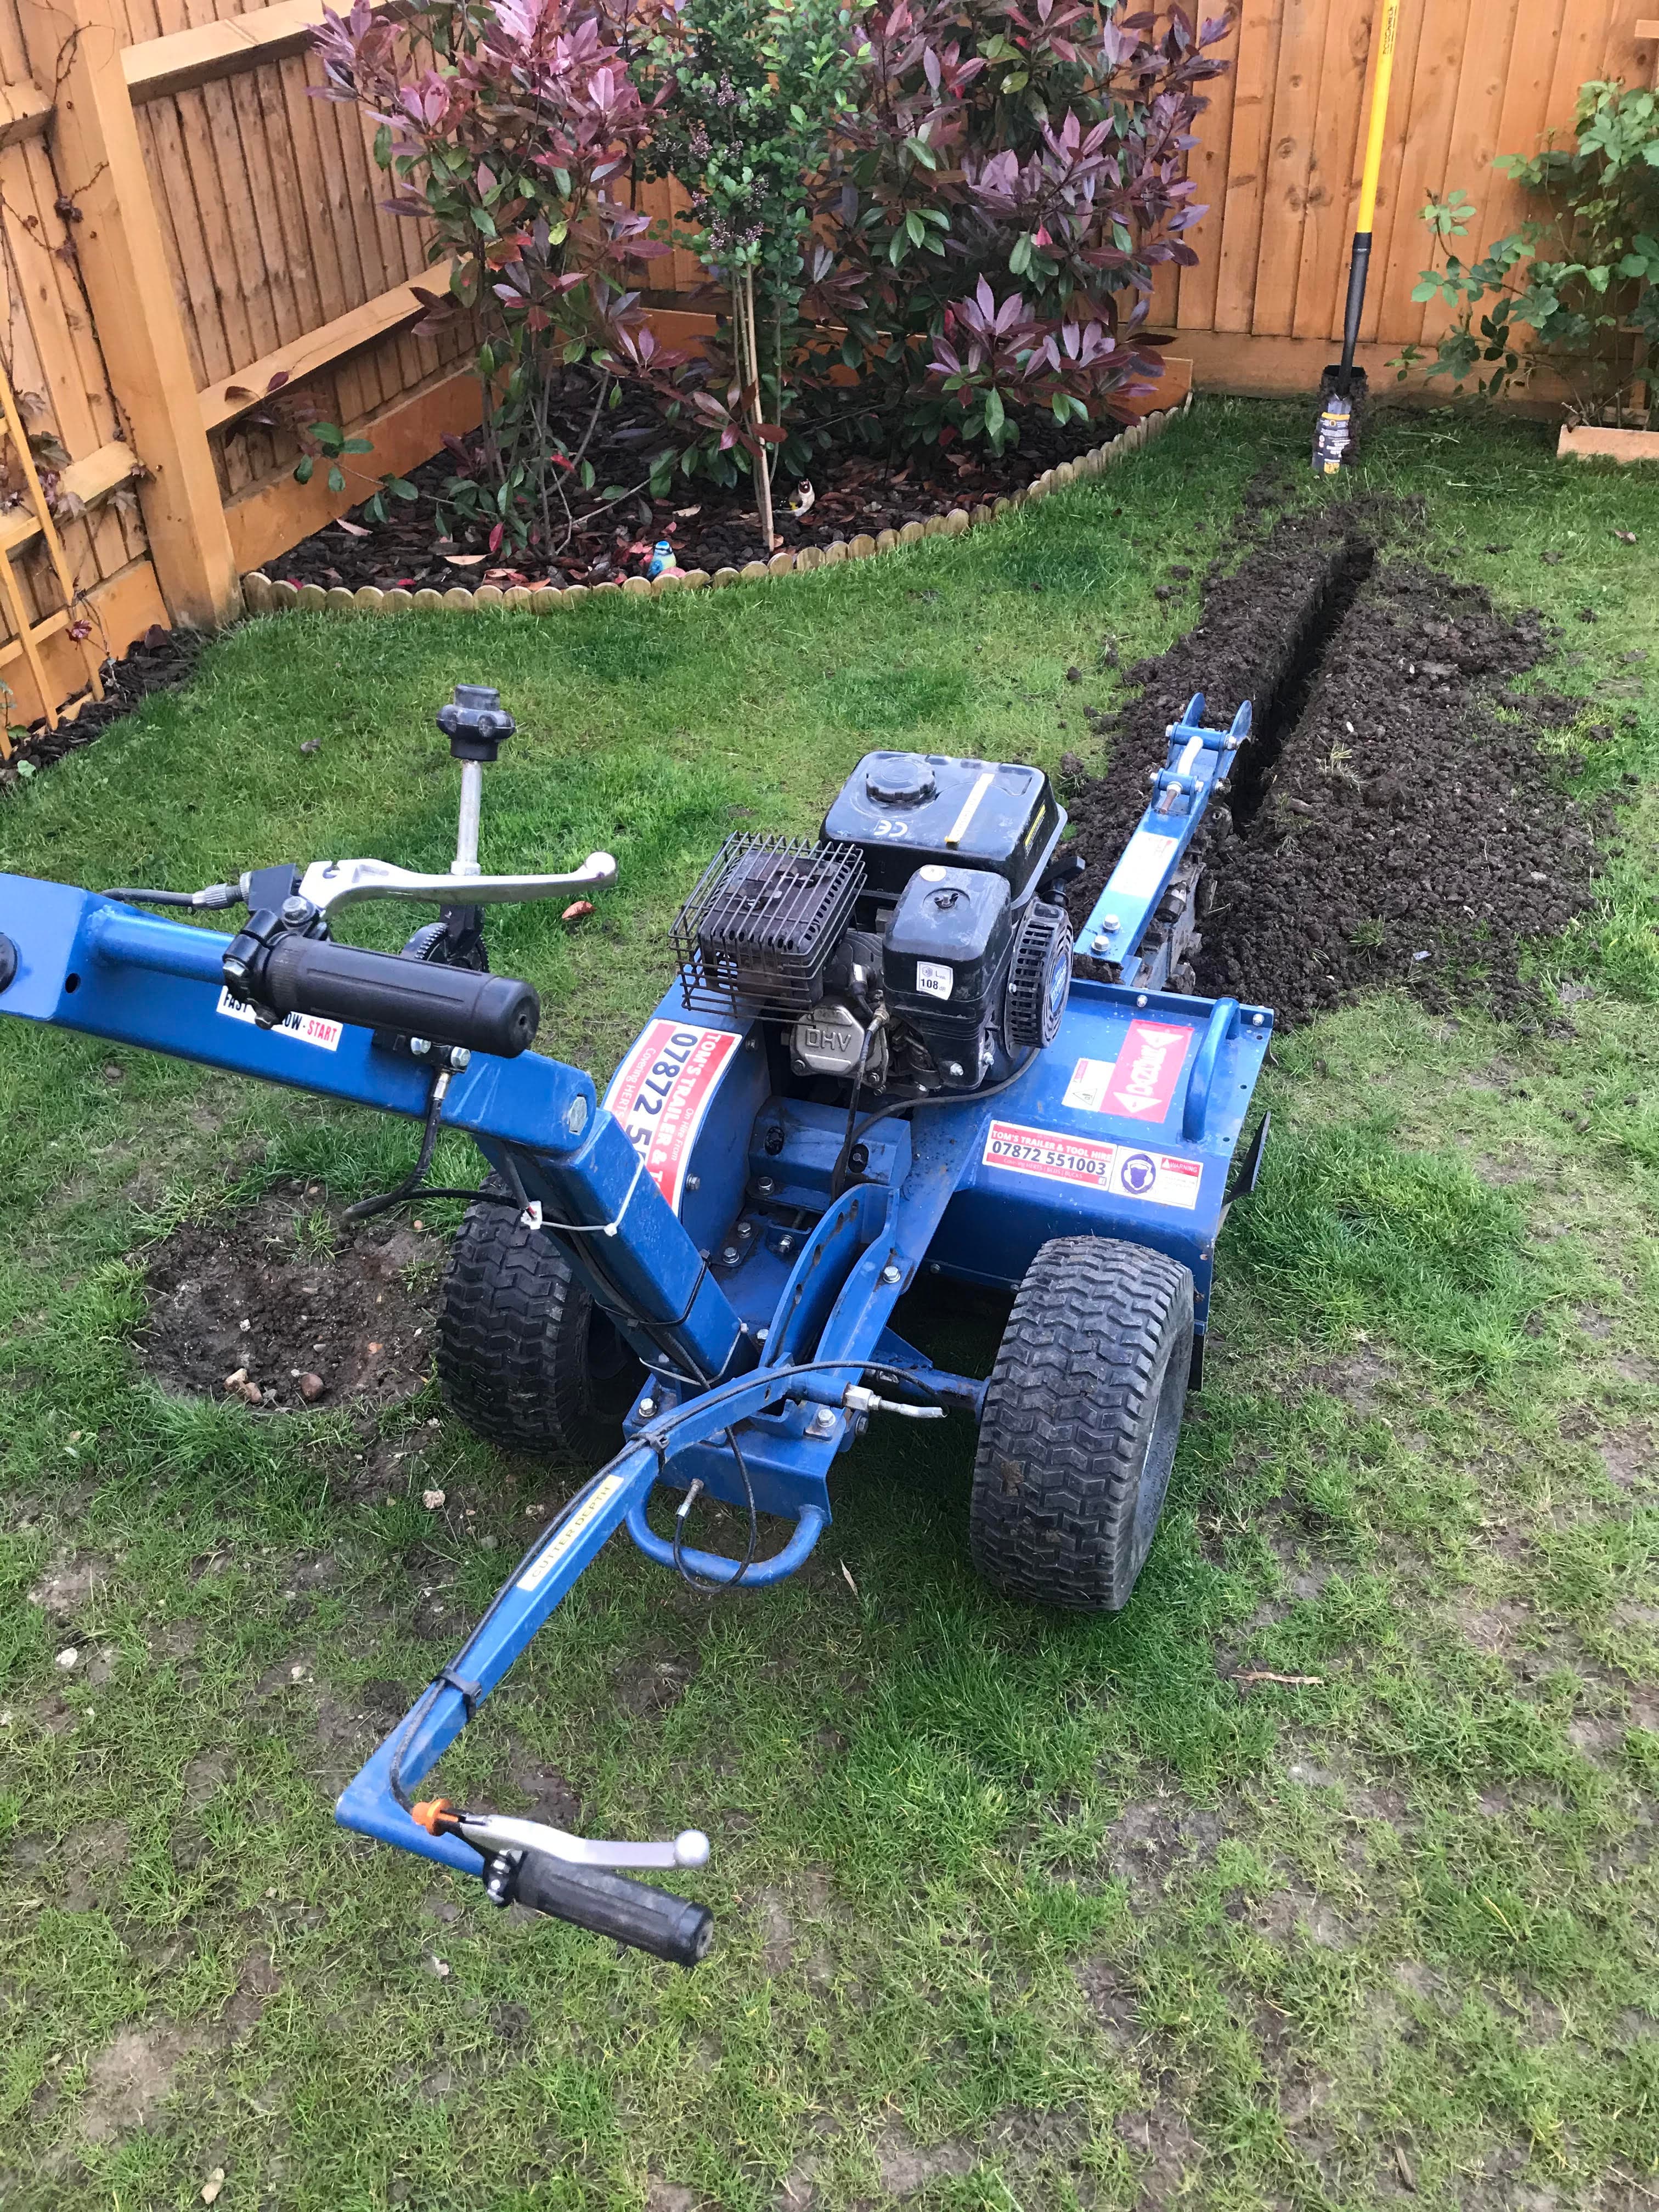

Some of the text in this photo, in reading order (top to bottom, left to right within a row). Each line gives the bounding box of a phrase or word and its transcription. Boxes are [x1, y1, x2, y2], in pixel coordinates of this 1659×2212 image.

[873, 820, 908, 837] CE
[921, 978, 938, 990] 108
[307, 1019, 338, 1043] START
[805, 1028, 851, 1052] OHV
[686, 1034, 722, 1076] TOM'S
[614, 1047, 656, 1118] Covering HERTS
[633, 1032, 698, 1115] 07872
[656, 1077, 697, 1146] TRAILER
[671, 1108, 694, 1161] On Hire From
[992, 1131, 1019, 1143] TOM'S
[1021, 1136, 1056, 1150] TRAILER
[1057, 1144, 1064, 1152] &
[1066, 1145, 1089, 1157] TOOL
[1091, 1151, 1112, 1161] HIRE
[651, 1149, 668, 1165] &
[992, 1141, 1106, 1175] 07872 551003
[1170, 1162, 1198, 1173] WARNING
[532, 1487, 611, 1578] CUTTER DEPTH
